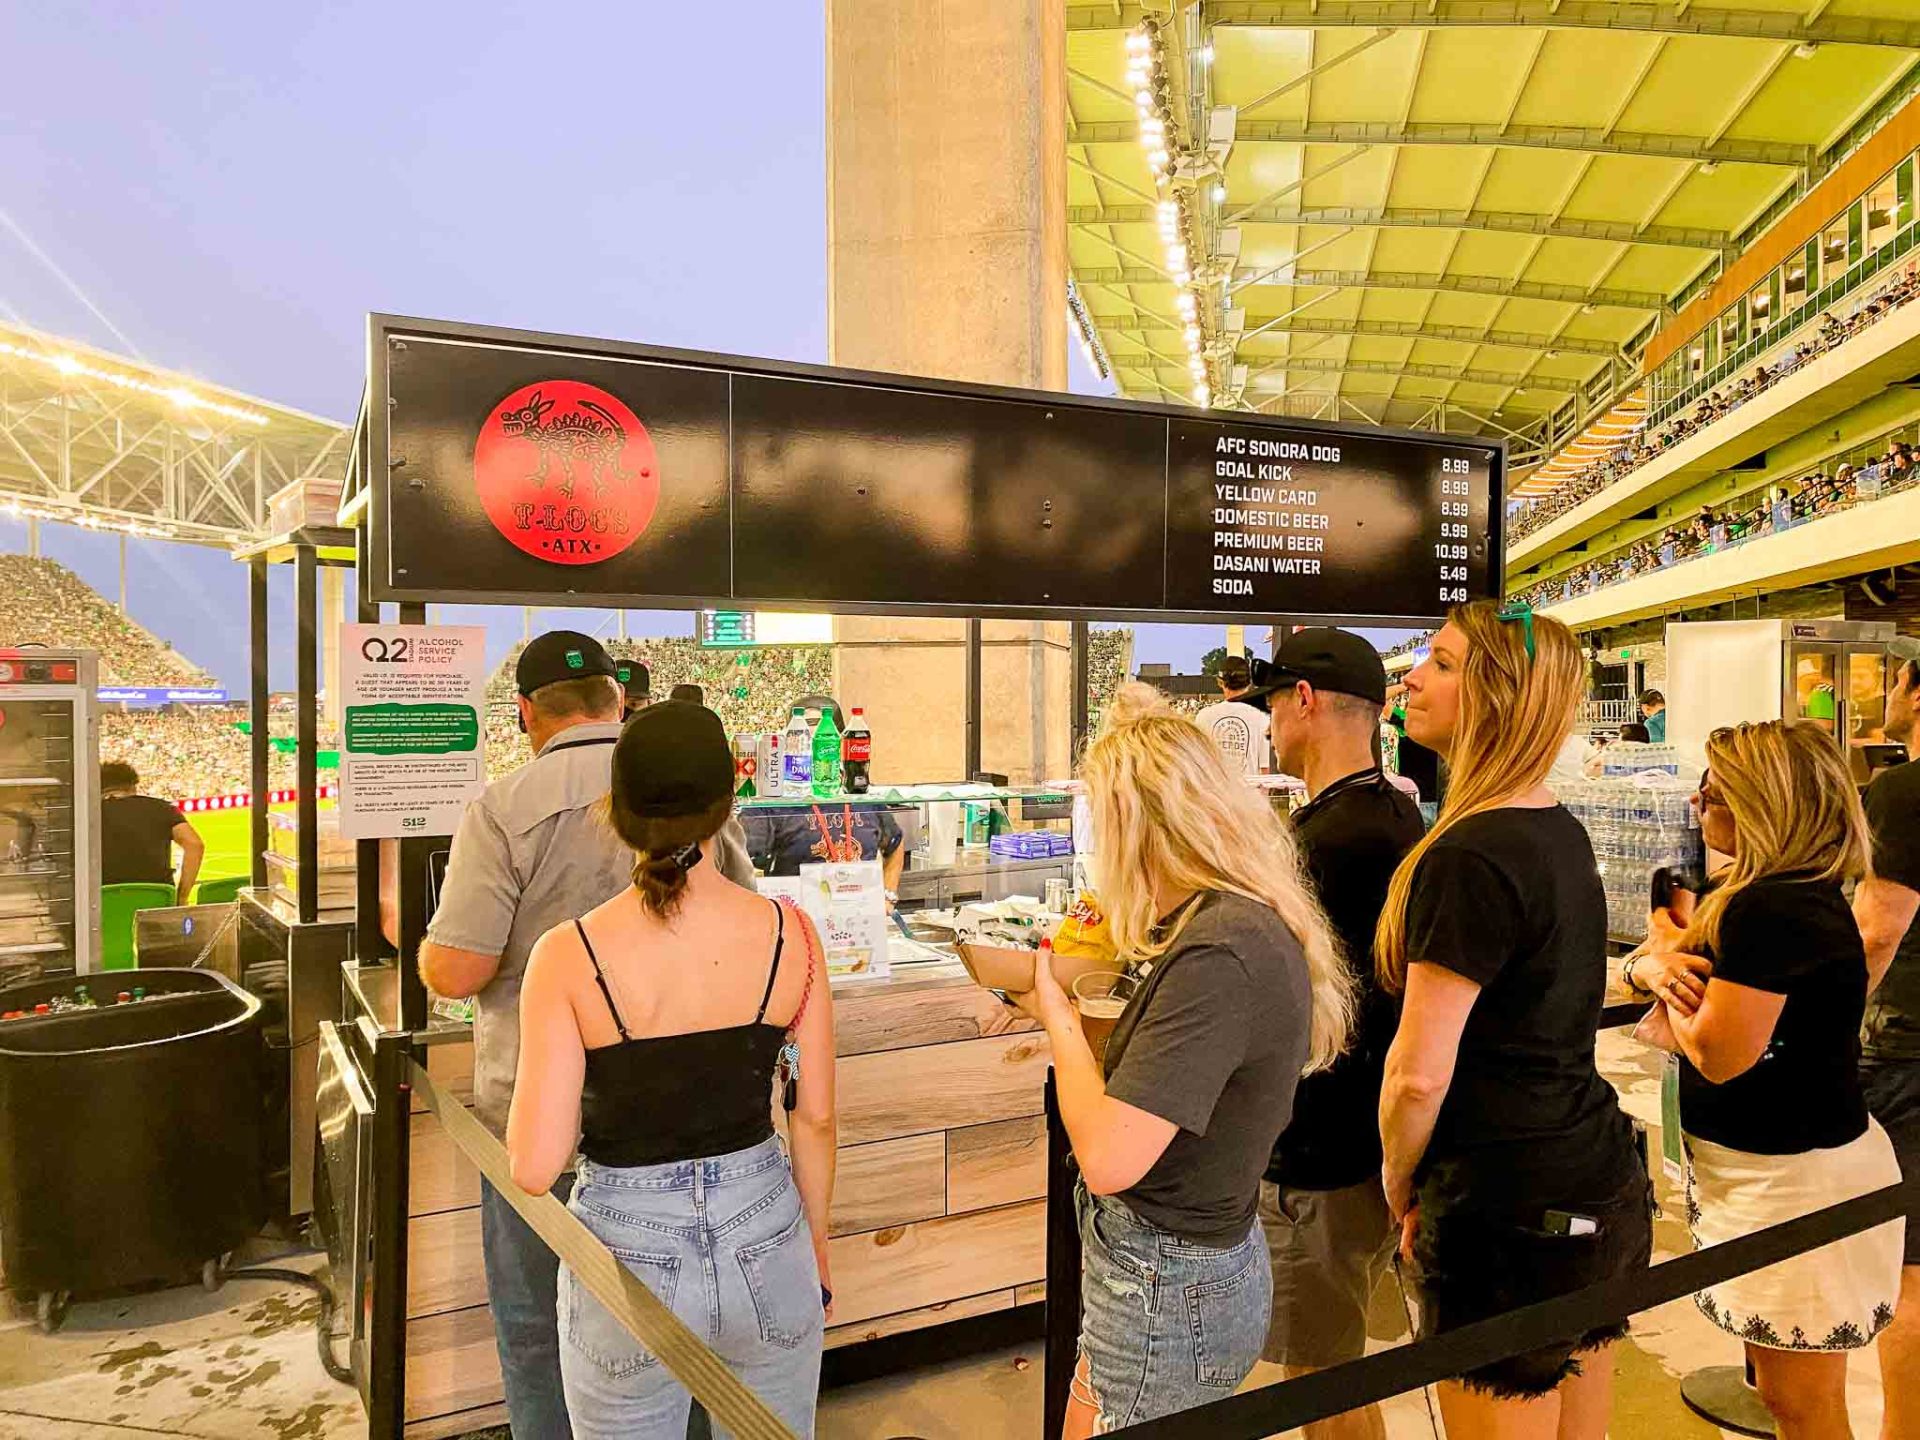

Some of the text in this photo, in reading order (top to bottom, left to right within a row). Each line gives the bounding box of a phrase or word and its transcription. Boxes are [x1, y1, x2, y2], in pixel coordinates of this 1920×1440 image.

[1216, 437, 1340, 462] AFC SONORA DOG
[1216, 460, 1292, 481] GOAL KICK
[1442, 458, 1469, 474] 8.99
[1215, 484, 1317, 506] YELLOW CARD
[1441, 479, 1469, 496] 8.99
[1441, 501, 1469, 517] 8.99
[1214, 508, 1329, 530] DOMESTIC BEER
[1441, 523, 1468, 538] 9.99
[1214, 531, 1324, 552] PREMIUM BEER
[1434, 544, 1468, 560] 10.99
[1214, 555, 1321, 575] DASANI WATER
[1440, 565, 1467, 581] 5.49
[1213, 578, 1253, 595] SODA
[1439, 587, 1467, 602] 6.49
[361, 637, 408, 663] Q2
[418, 638, 464, 646] ALCOHOL
[418, 647, 456, 655] SERVICE
[418, 656, 453, 664] POLICY
[770, 751, 779, 788] ULTRA
[402, 816, 427, 827] 512
